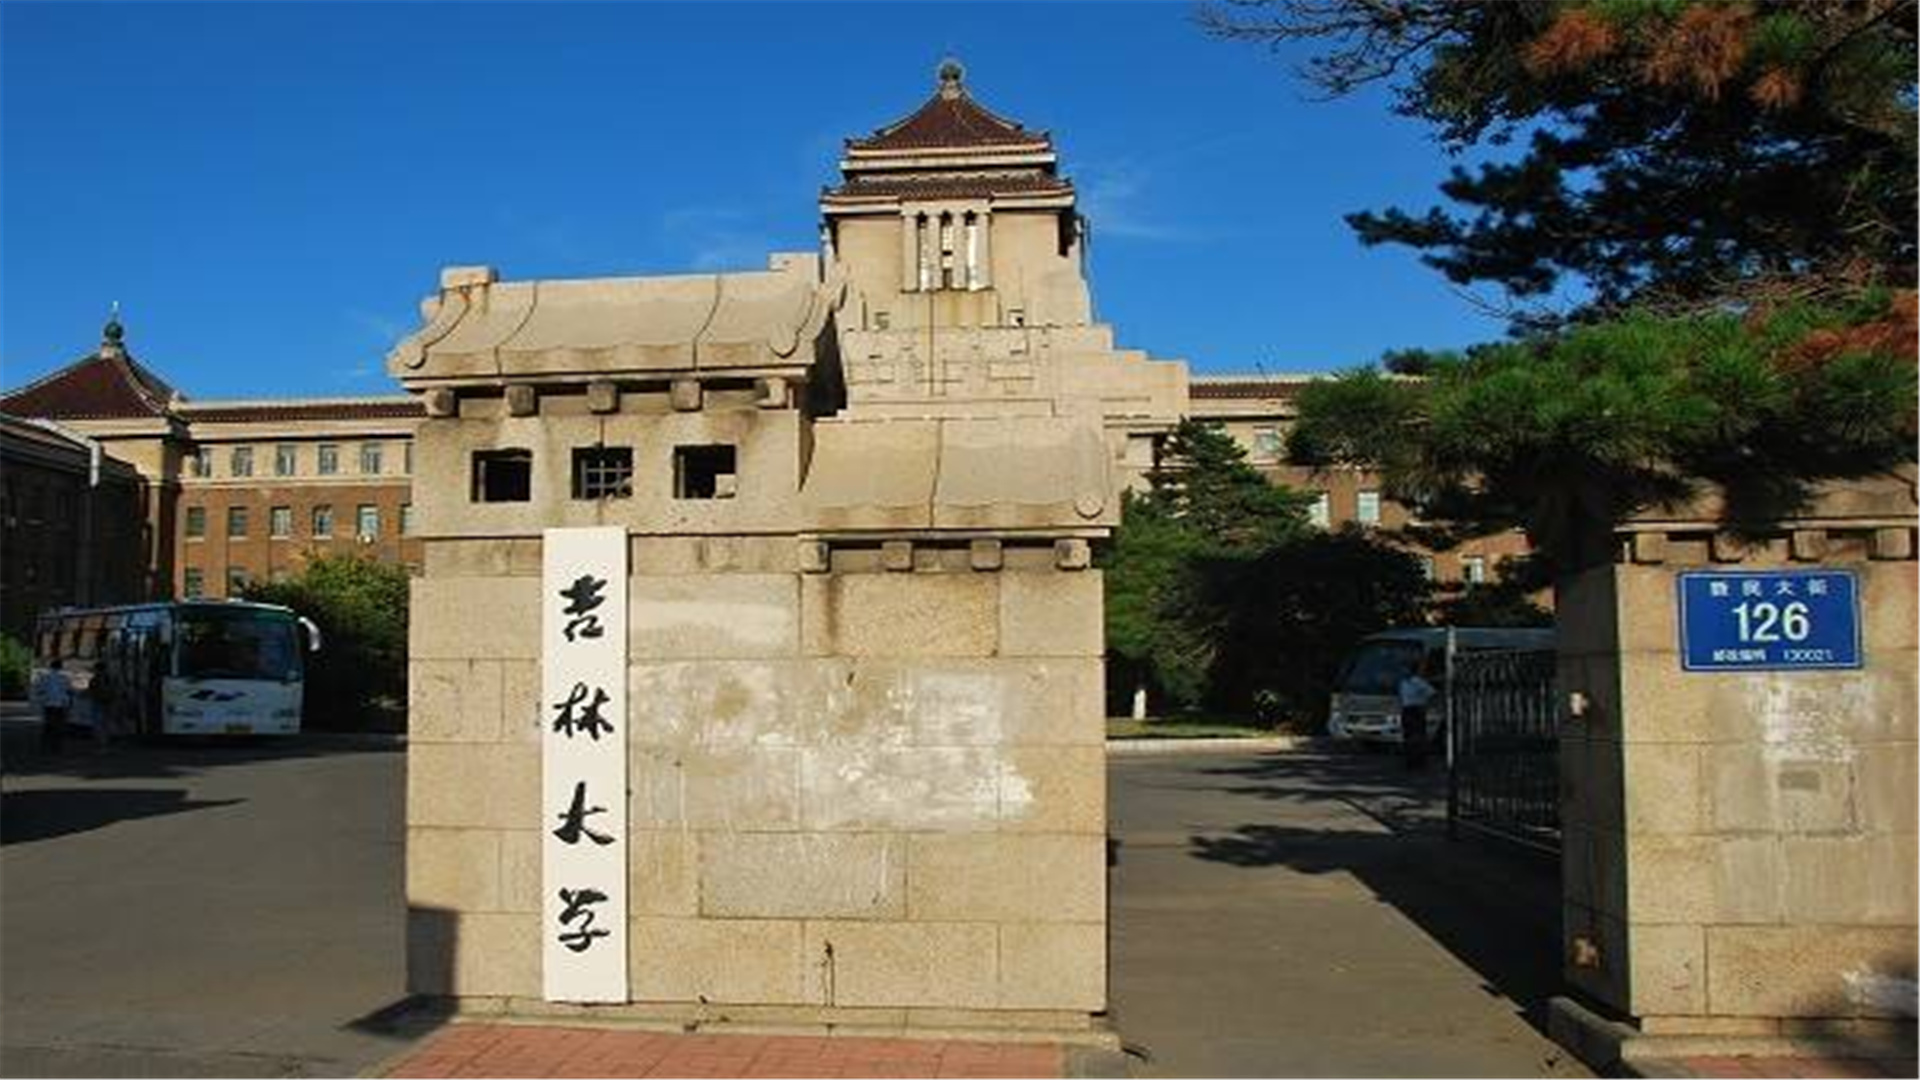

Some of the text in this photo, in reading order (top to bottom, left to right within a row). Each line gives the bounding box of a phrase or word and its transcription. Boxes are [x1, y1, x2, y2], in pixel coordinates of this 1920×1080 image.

[1731, 601, 1810, 641] 126
[553, 574, 615, 952] 吉林大学
